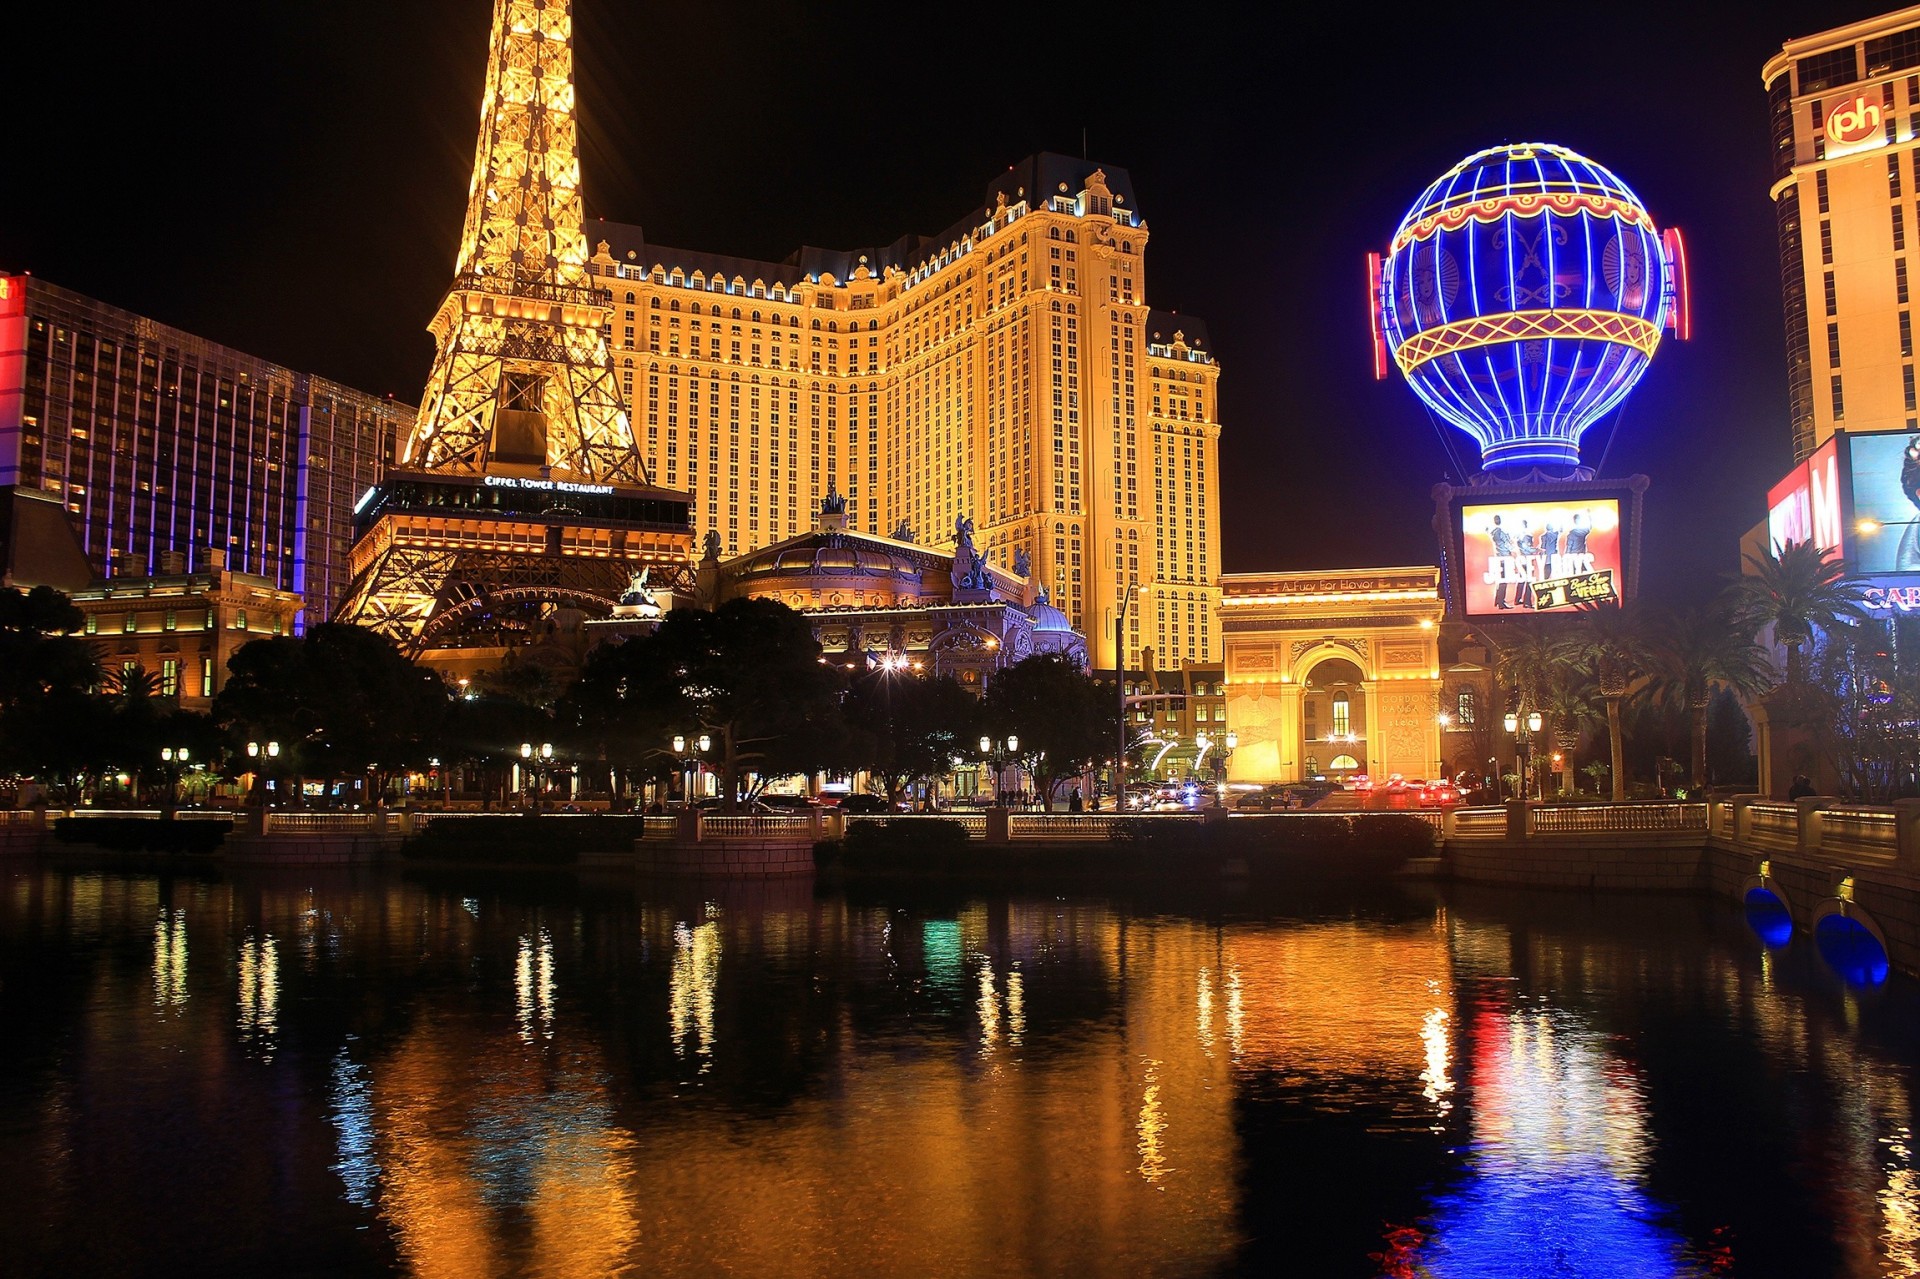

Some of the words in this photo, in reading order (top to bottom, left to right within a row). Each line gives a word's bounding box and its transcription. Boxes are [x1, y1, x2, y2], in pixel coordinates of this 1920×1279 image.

[1833, 98, 1880, 140] ph
[557, 482, 614, 494] RESTAURANT
[1483, 555, 1547, 585] JERSEY
[1551, 553, 1595, 578] BOYS
[1535, 579, 1569, 590] RATED
[1576, 583, 1611, 598] VEGAS
[1383, 694, 1427, 703] GORDON
